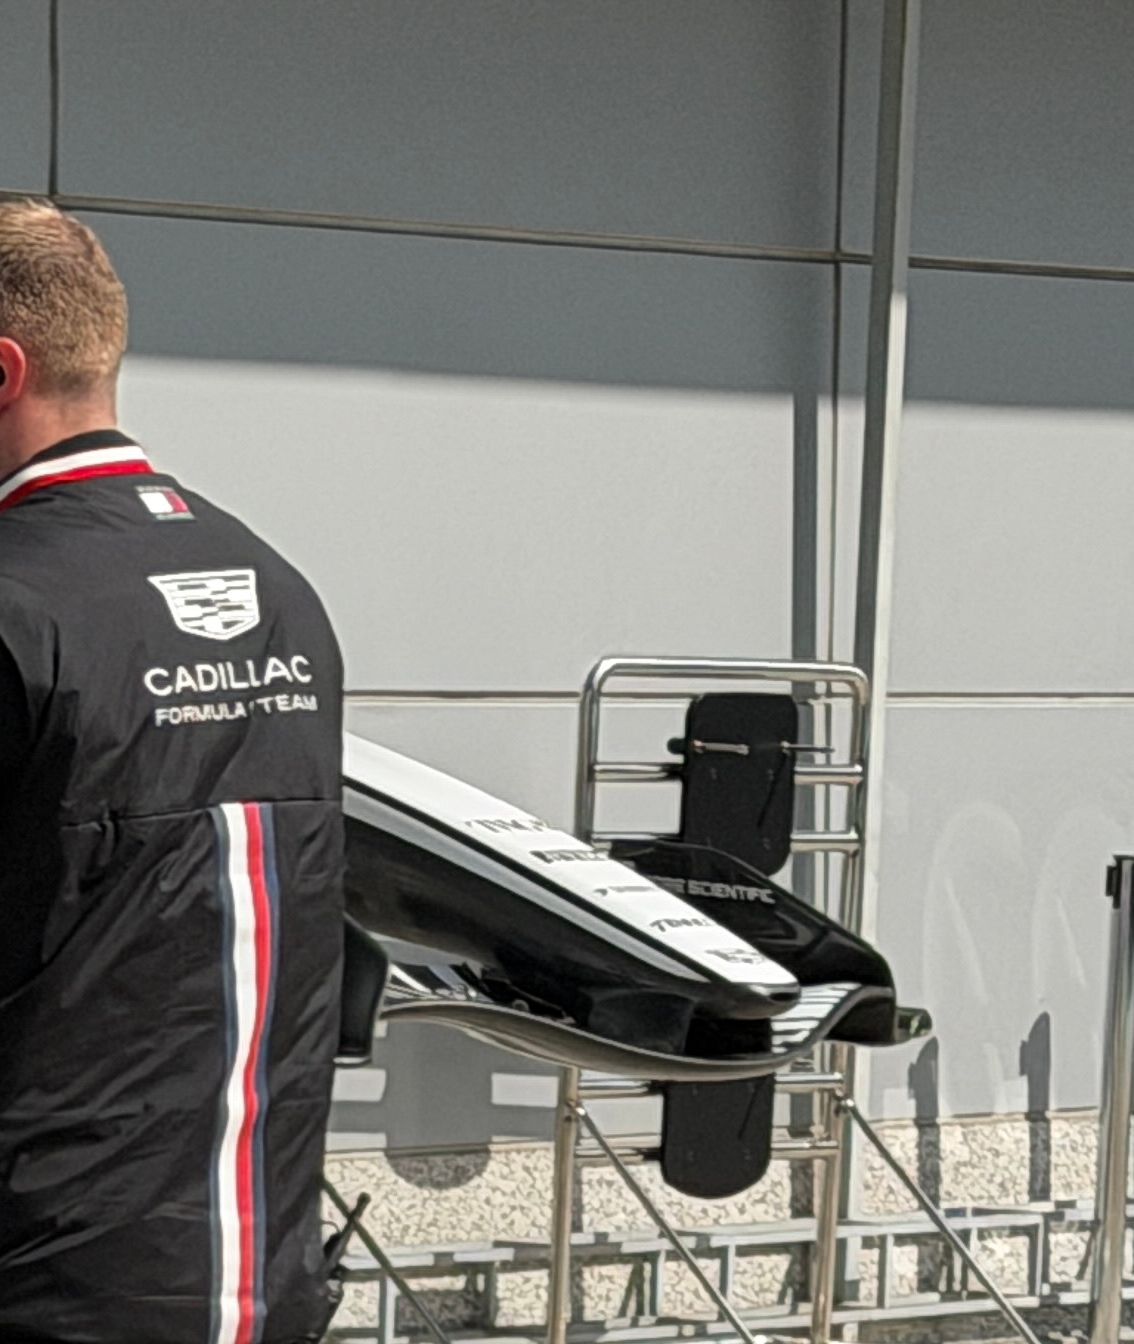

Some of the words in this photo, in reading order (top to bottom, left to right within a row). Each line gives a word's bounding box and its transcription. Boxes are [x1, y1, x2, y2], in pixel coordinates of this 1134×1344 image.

[144, 655, 313, 697] CADILLAC
[154, 701, 248, 727] FORMULA
[255, 694, 318, 714] TEAM
